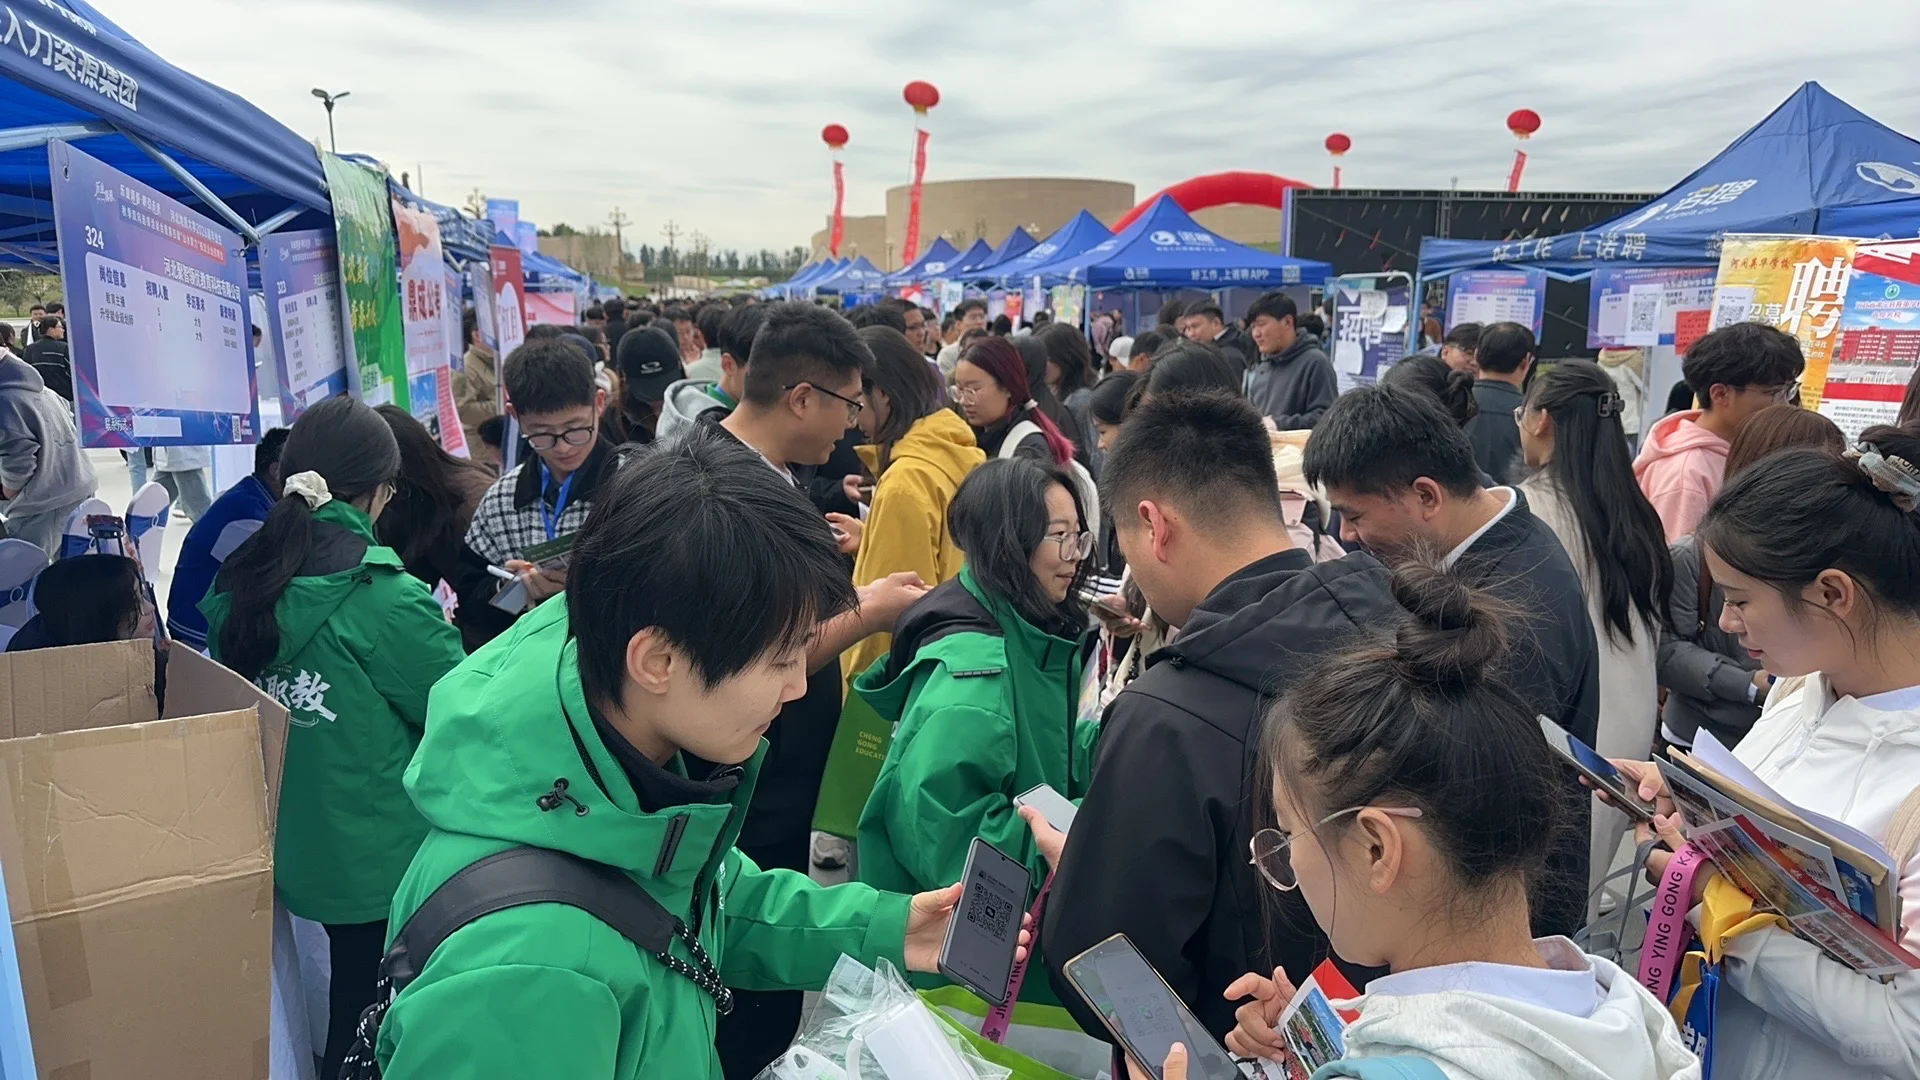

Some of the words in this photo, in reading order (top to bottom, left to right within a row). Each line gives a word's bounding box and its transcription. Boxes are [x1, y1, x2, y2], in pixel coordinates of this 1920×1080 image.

[0, 5, 139, 112] 人力资源集团
[85, 225, 104, 249] 324
[1571, 231, 1647, 260] 上诺聘
[98, 264, 127, 289] 岗位信息
[145, 279, 170, 301] 招聘人数
[1780, 256, 1853, 339] 聘
[253, 668, 337, 722] 职教
[857, 738, 877, 750] GONG
[859, 731, 882, 744] CHENG
[1662, 871, 1683, 917] GONG
[1652, 922, 1671, 960] YING
[1647, 966, 1662, 996] ING
